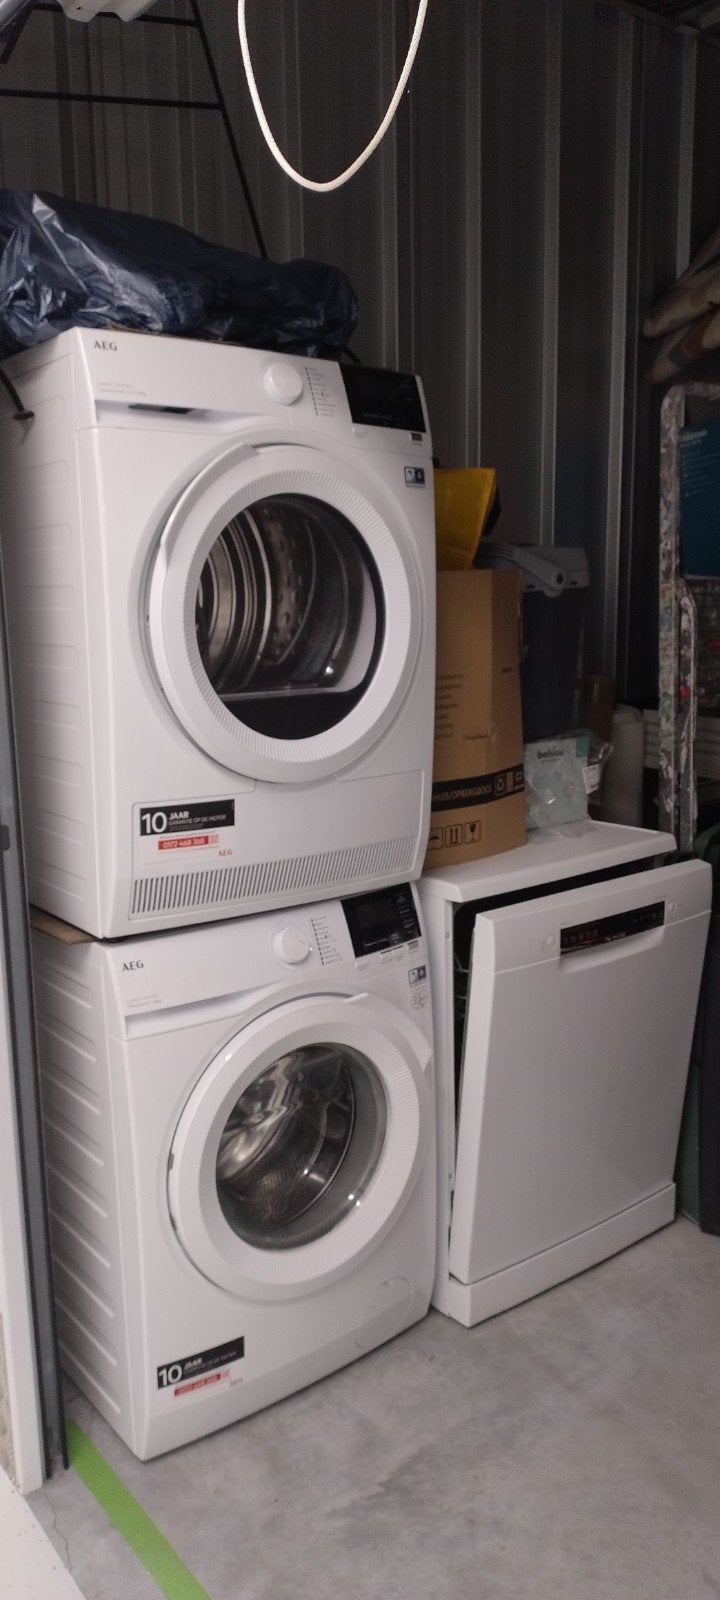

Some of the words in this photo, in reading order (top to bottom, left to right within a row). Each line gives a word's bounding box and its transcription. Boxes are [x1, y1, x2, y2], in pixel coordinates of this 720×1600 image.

[93, 340, 118, 352] AEG
[169, 811, 190, 821] JAAR
[209, 814, 227, 822] MOTOR
[141, 811, 168, 834] 10
[218, 848, 233, 857] AEG
[122, 959, 145, 971] AEG
[158, 1364, 183, 1387] 10
